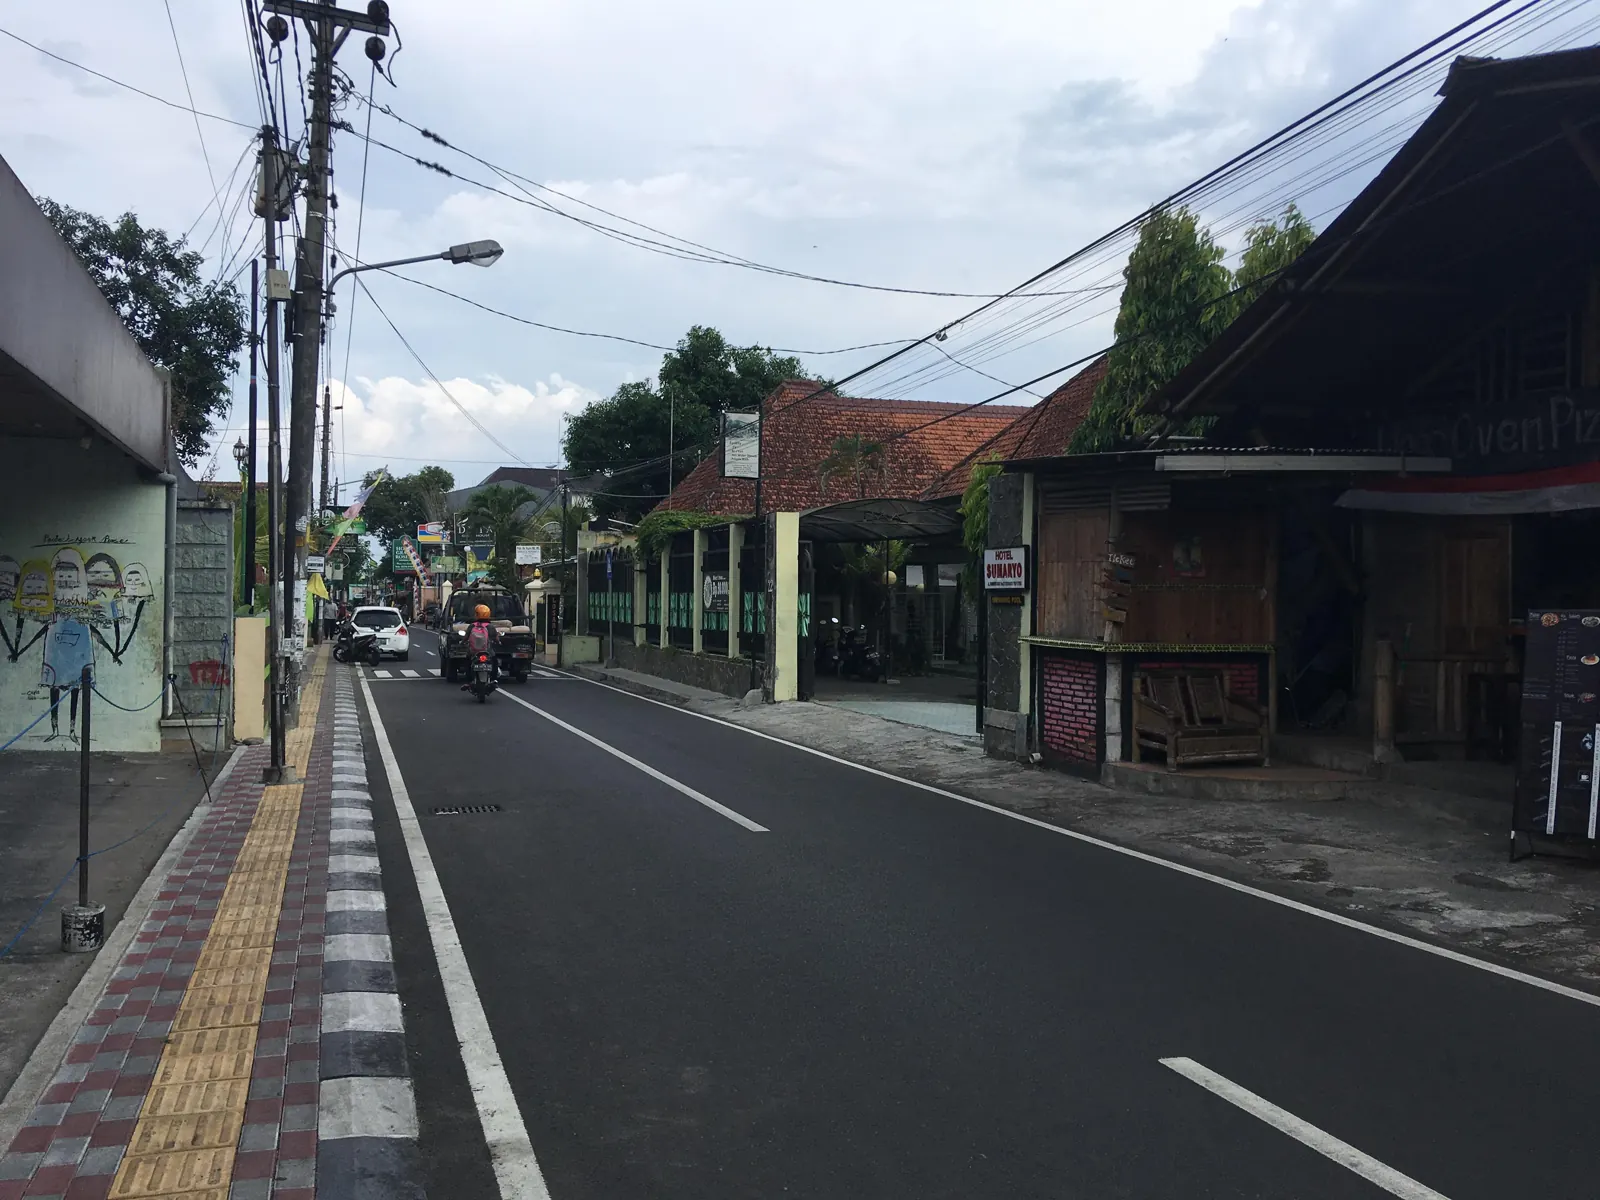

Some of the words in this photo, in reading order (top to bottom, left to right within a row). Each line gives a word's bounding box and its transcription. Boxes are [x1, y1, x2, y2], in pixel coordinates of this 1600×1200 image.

[1451, 412, 1544, 458] Oven
[995, 550, 1013, 561] HOTEL
[986, 562, 1022, 579] SUMARYO
